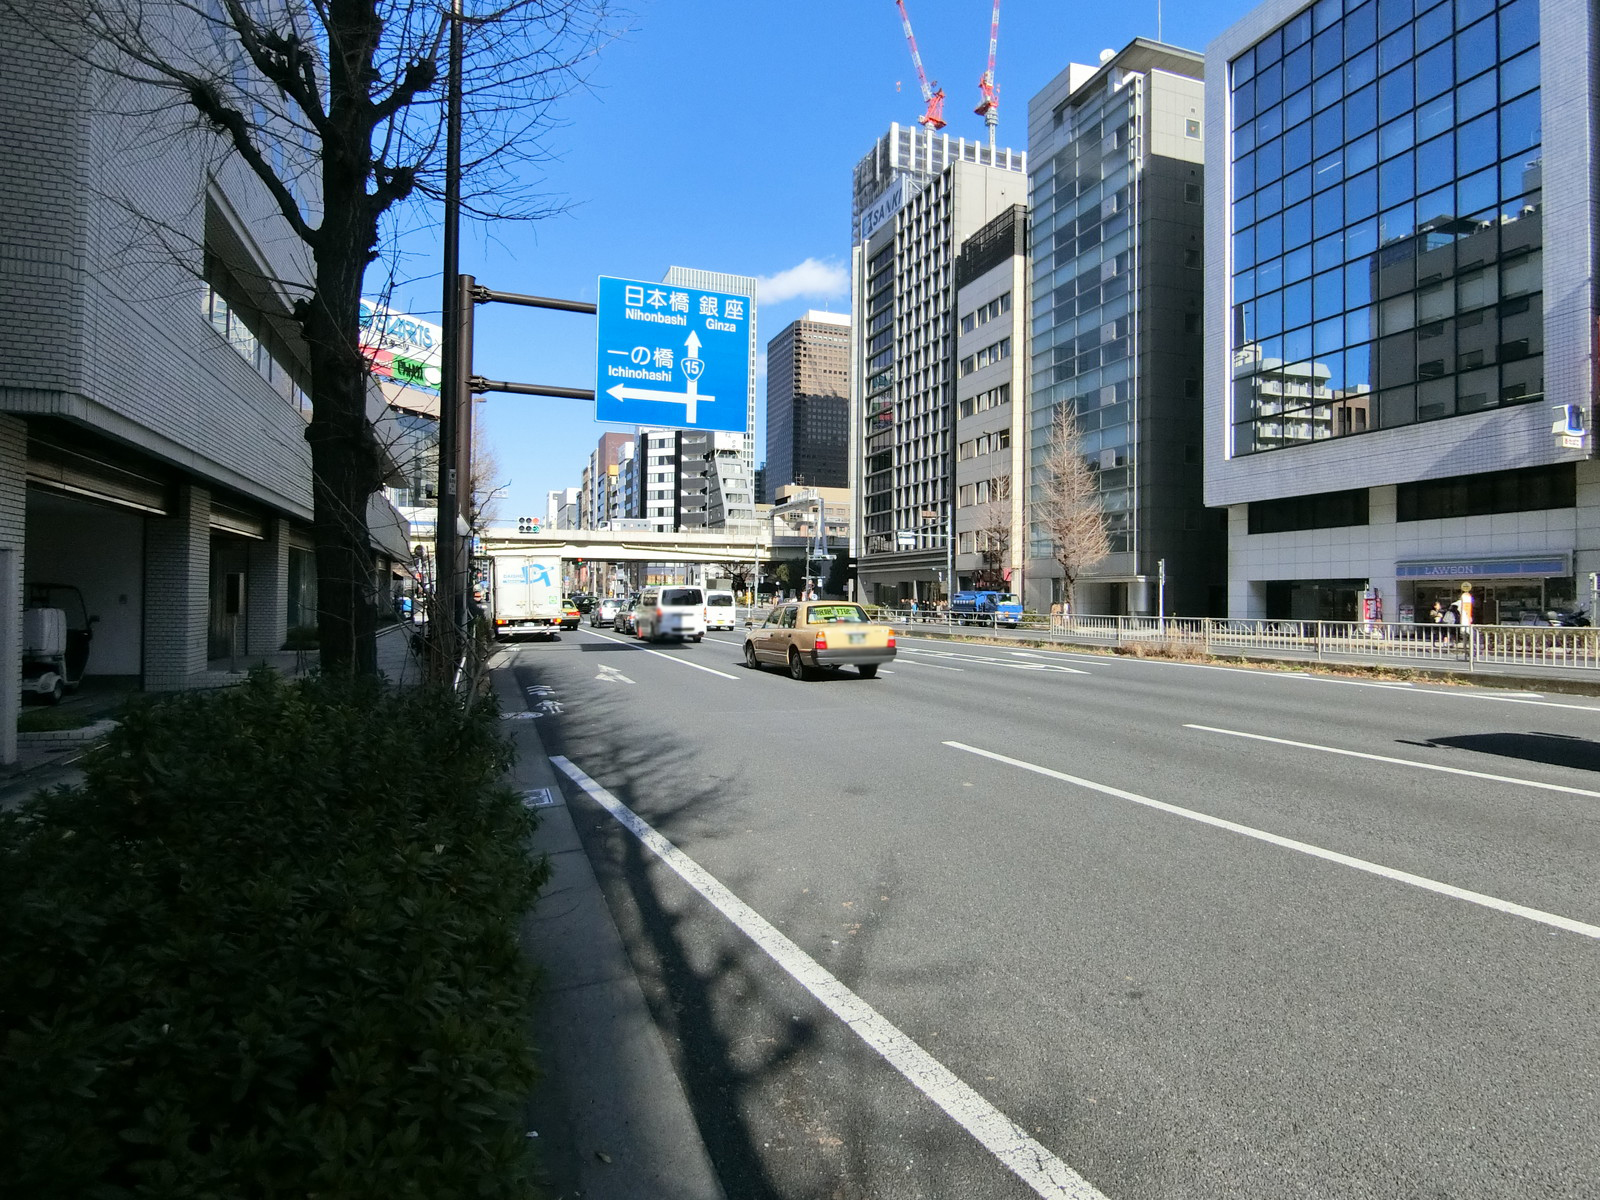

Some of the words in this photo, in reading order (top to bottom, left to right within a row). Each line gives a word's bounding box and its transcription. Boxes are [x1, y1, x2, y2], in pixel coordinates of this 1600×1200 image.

[625, 285, 690, 313] 日本橋
[699, 295, 744, 321] 銀座
[625, 308, 687, 326] Nihonbashi
[705, 318, 737, 332] Ginza
[607, 346, 675, 369] 一の橋
[608, 365, 672, 382] Ichinohashi
[685, 361, 700, 375] 15
[1425, 566, 1474, 575] LAWSON
